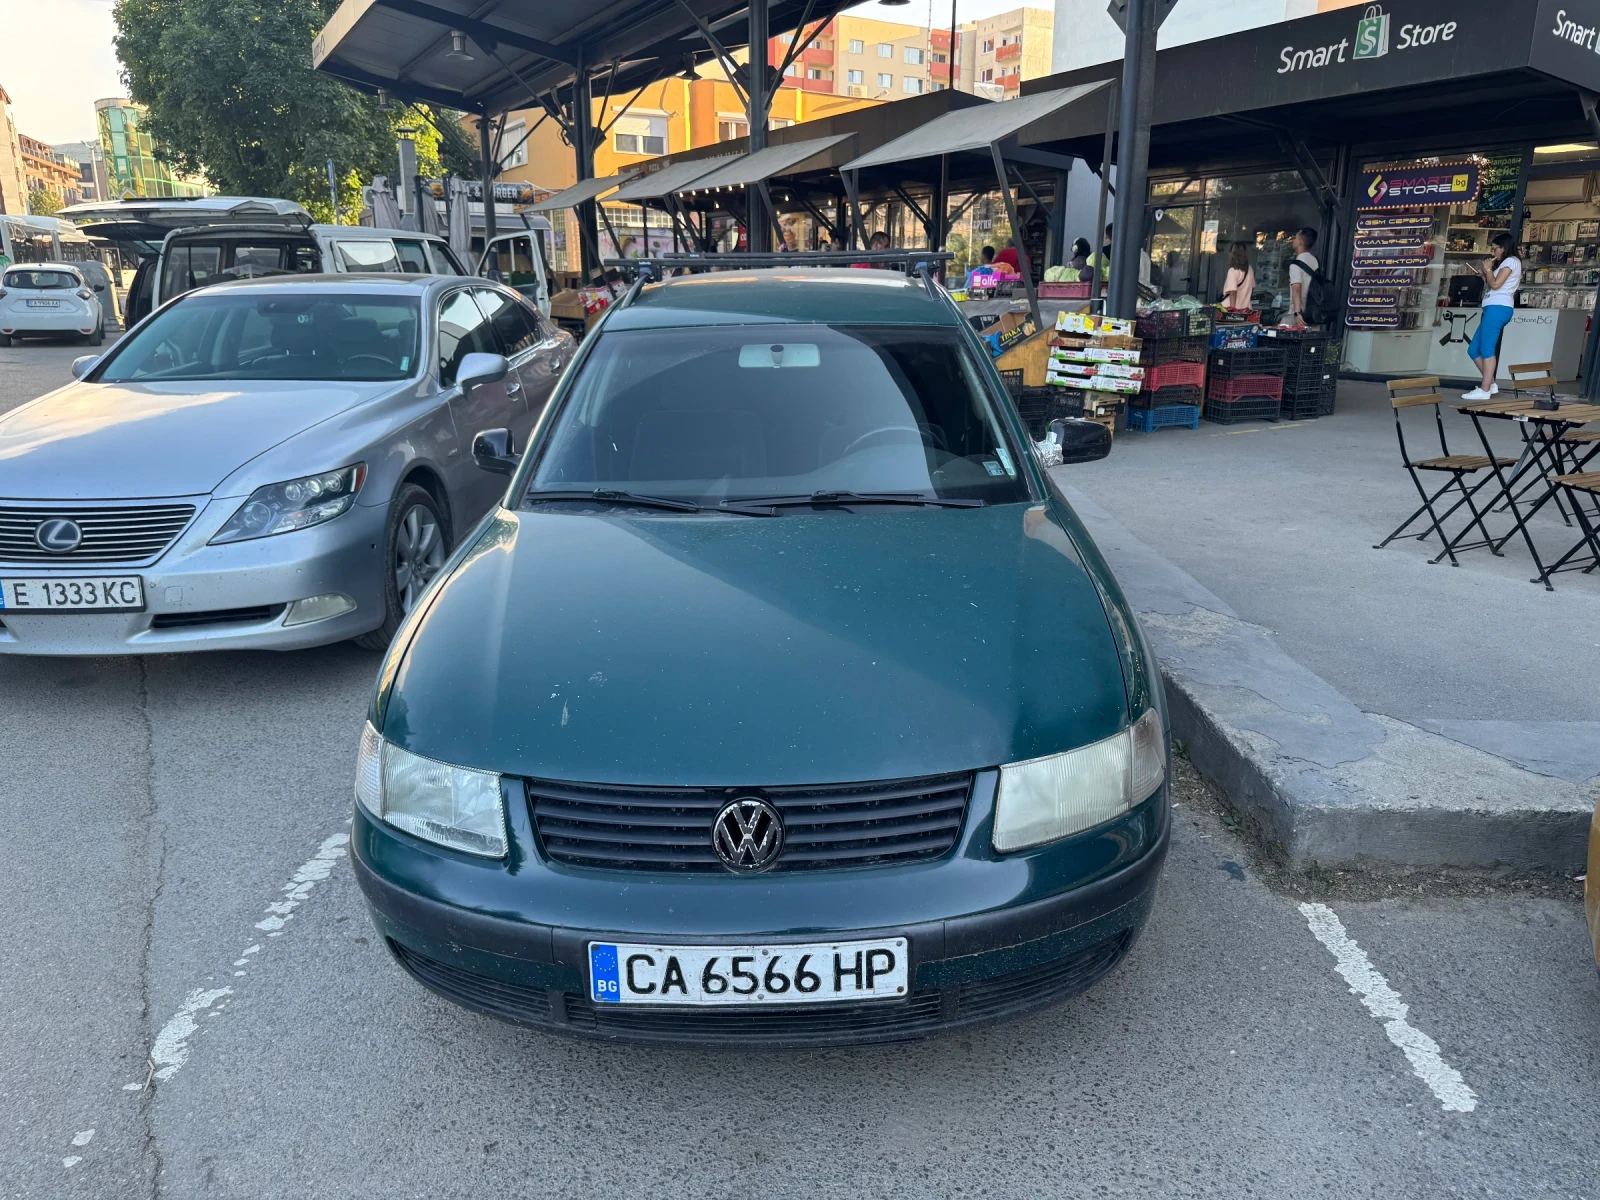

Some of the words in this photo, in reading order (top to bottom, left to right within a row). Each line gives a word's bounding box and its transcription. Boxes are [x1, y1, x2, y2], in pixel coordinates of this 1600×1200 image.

[1552, 9, 1596, 50] Smart
[1277, 38, 1349, 74] Smart
[1396, 21, 1457, 50] Store
[1388, 183, 1453, 197] STORE
[1390, 175, 1453, 188] SMART
[1453, 177, 1466, 189] .bg
[13, 583, 30, 605] E
[42, 582, 98, 605] 1333
[102, 581, 137, 605] KC
[626, 953, 688, 995] CA
[701, 953, 822, 995] 6566
[832, 948, 896, 992] HP
[597, 979, 618, 992] BG
